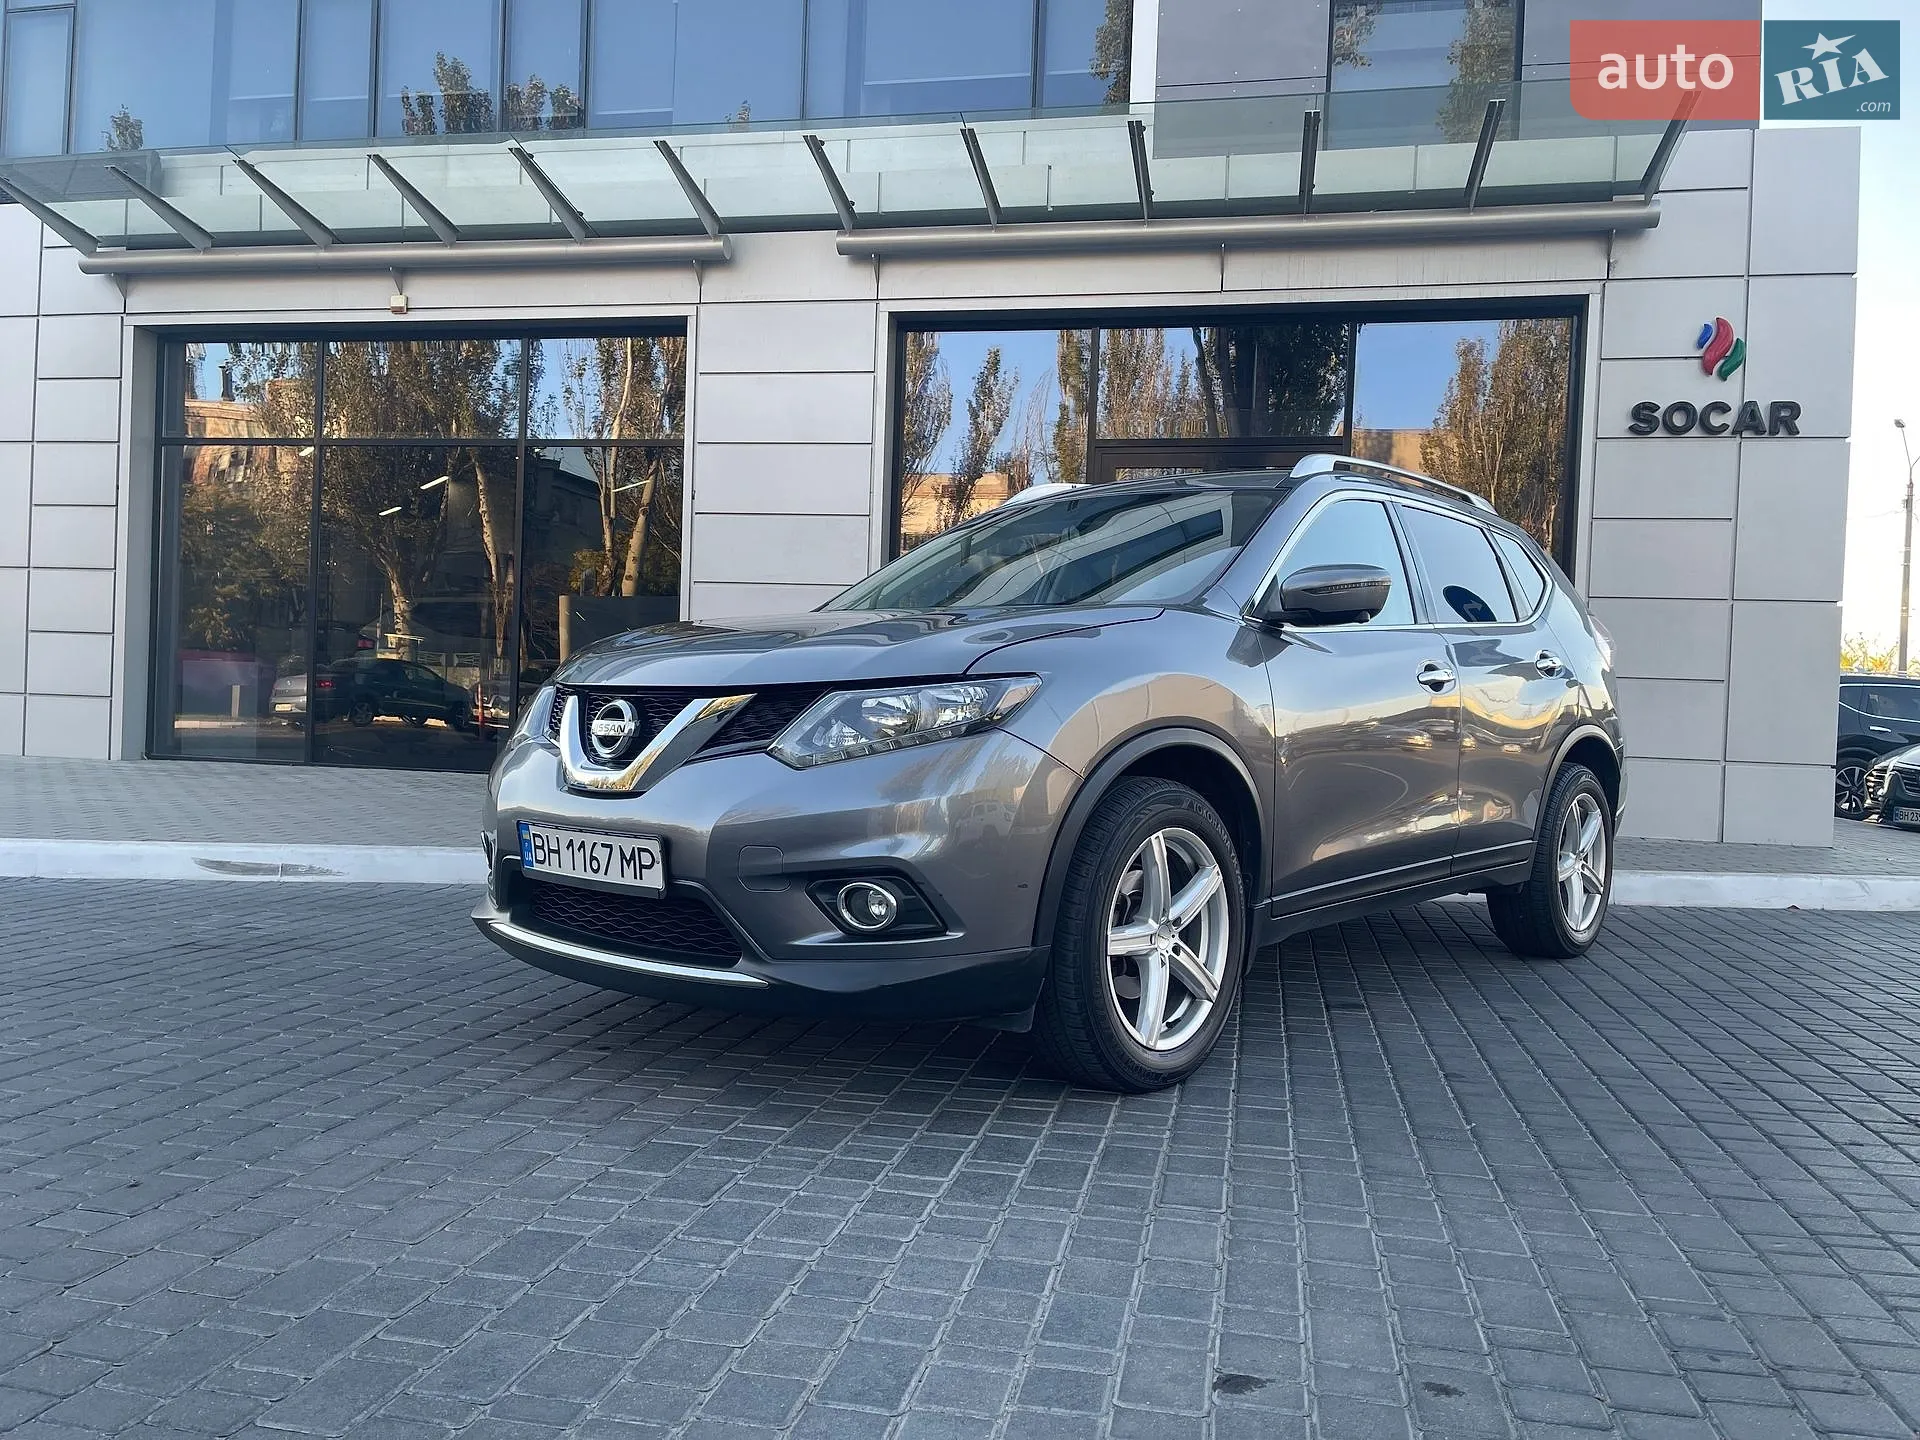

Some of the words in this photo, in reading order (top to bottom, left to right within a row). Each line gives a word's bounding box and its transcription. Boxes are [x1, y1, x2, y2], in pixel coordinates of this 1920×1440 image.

[1629, 401, 1801, 435] SOCAR
[524, 851, 532, 862] UA
[532, 832, 561, 868] BH
[566, 838, 613, 875] 1167
[619, 844, 655, 880] MP
